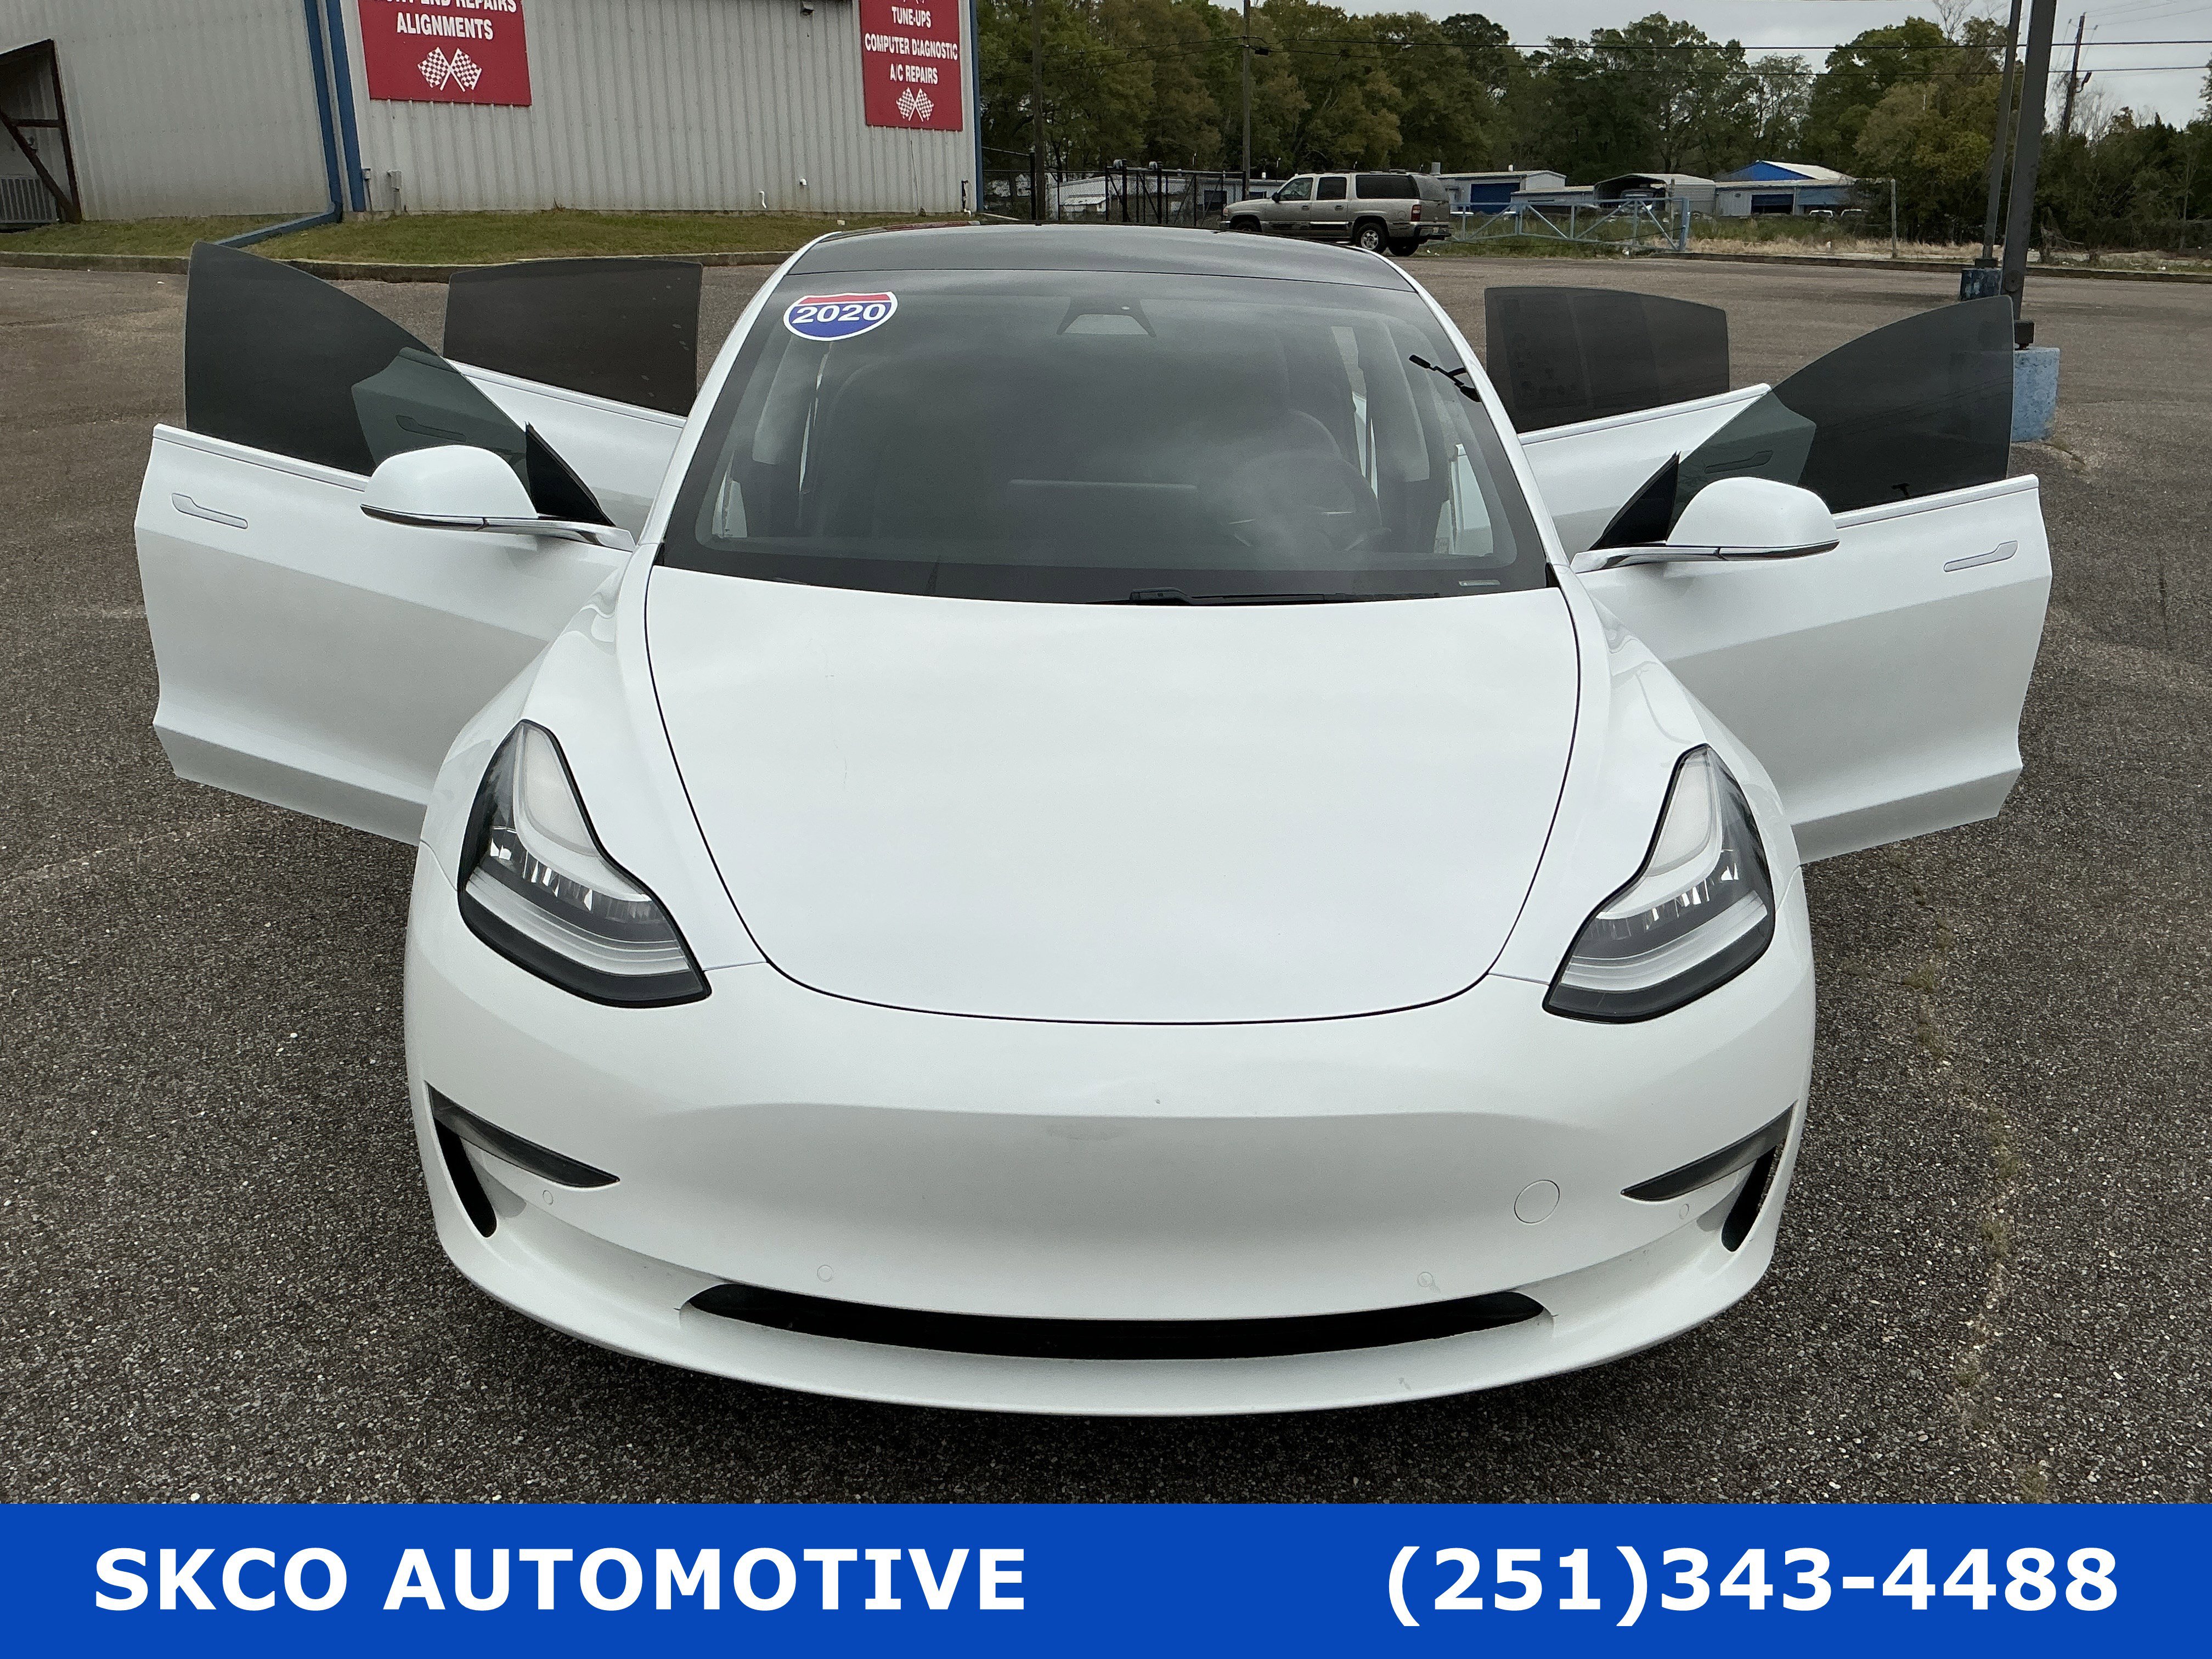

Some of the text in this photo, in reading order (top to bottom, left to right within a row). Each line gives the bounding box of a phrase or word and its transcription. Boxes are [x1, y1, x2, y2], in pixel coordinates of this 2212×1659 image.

[397, 12, 493, 40] ALIGNMENTS
[891, 6, 932, 28] TUNE-UPS
[865, 33, 958, 60] COMPUTER DIAGNOSTIC
[890, 63, 938, 84] A/C REPAIRS
[792, 303, 887, 324] 2020
